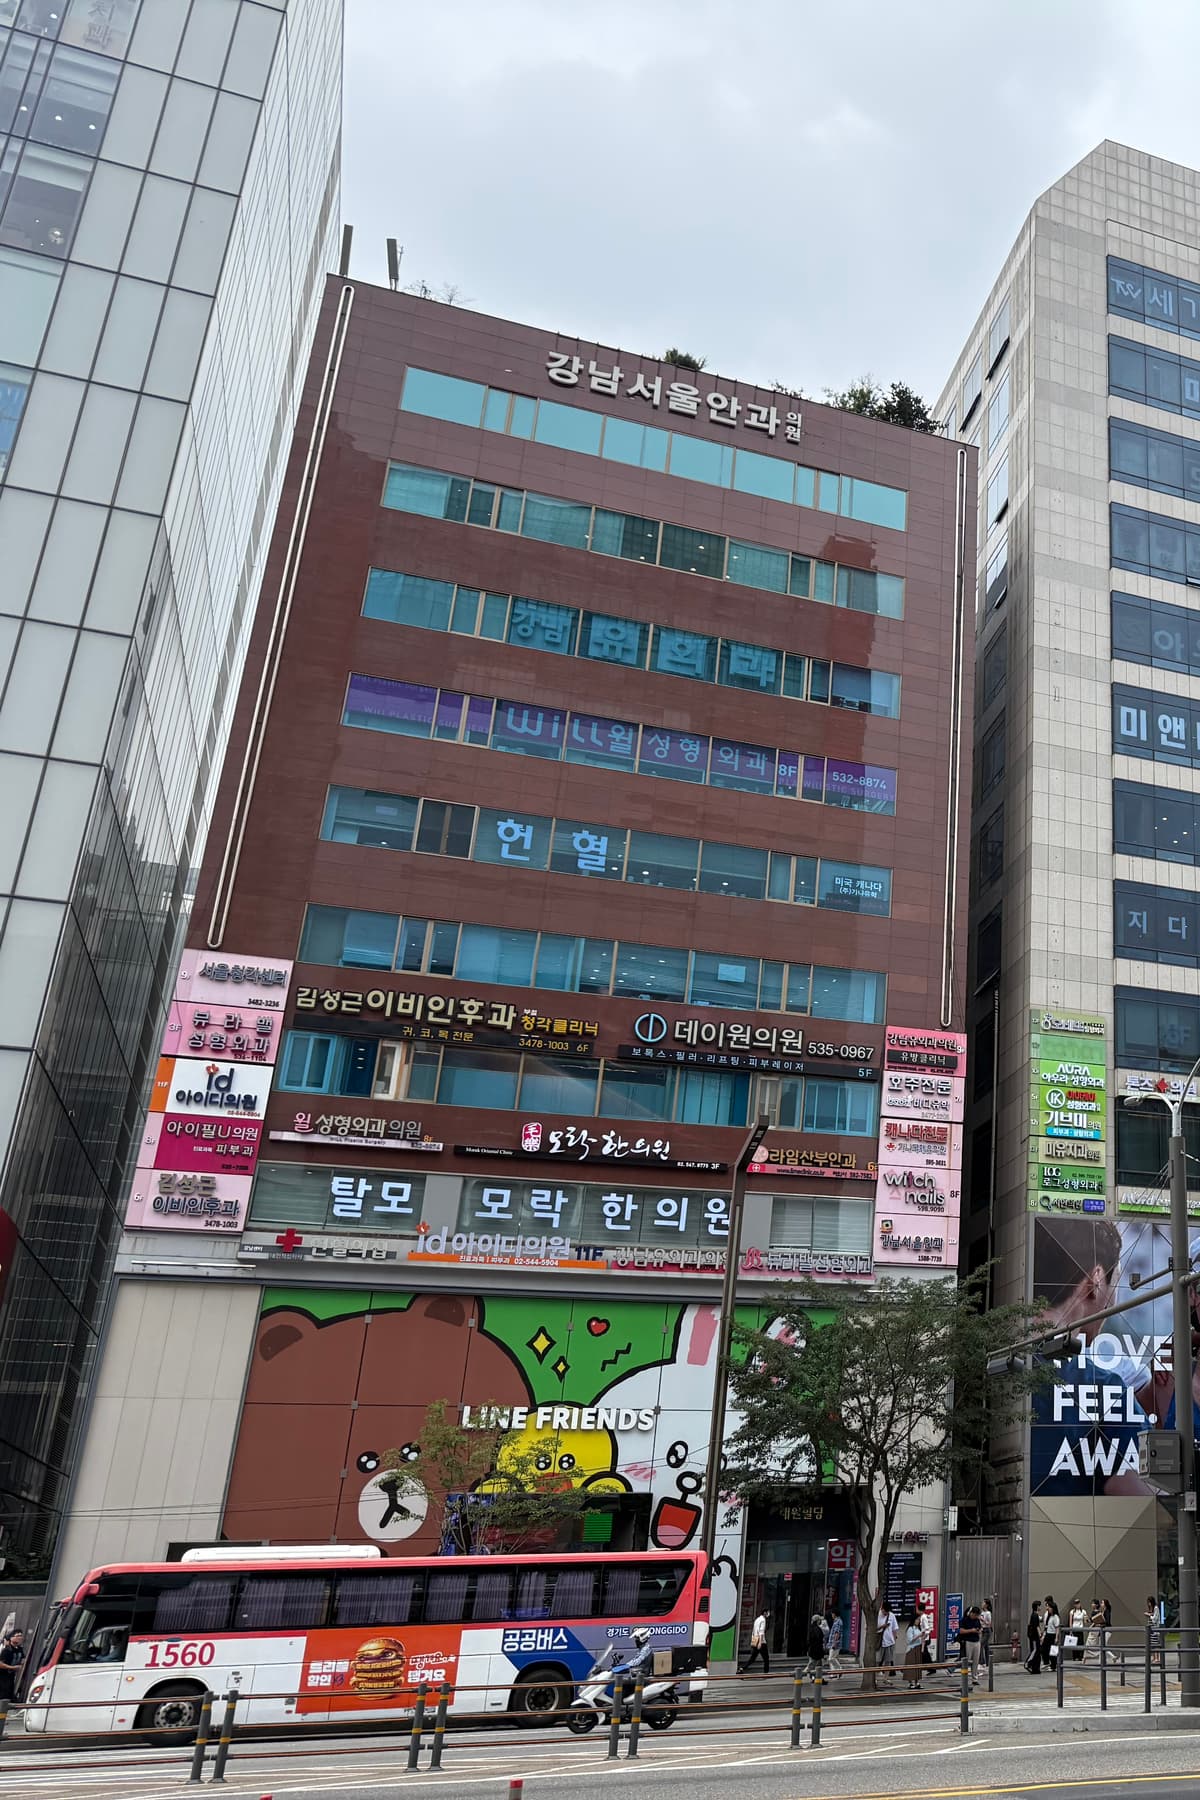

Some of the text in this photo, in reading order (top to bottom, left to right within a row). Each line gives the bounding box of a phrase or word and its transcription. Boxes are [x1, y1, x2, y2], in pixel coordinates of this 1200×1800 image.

[545, 350, 784, 438] 강남서울안과
[778, 764, 797, 777] 8F
[832, 772, 886, 789] 532-8874
[835, 876, 882, 891] 미국 캐나다
[452, 1030, 474, 1042] 전문
[521, 1015, 599, 1036] 청각클리닉
[188, 1032, 269, 1053] 성형외과
[519, 1038, 589, 1053] 3478-1003 6F
[674, 1019, 874, 1060] 데이원의원 535-0967
[207, 1066, 234, 1092] id
[858, 1067, 872, 1078] 5F
[176, 1089, 257, 1111] 아이디의원
[1043, 1110, 1087, 1129] 기브미
[885, 1122, 948, 1144] 캐나다전문
[215, 1144, 253, 1157] 피부과
[769, 1148, 856, 1169] 라임산부인과
[1046, 1141, 1088, 1160] 미유치과
[884, 1171, 935, 1188] witch
[153, 1196, 240, 1218] 이비인후과
[331, 1176, 729, 1236] 탈모 모락 한의원
[905, 1189, 960, 1206] nails 8F
[416, 1224, 604, 1261] id 아이디의원 11F
[1053, 1385, 1158, 1423] FEEL.
[462, 1405, 654, 1431] LINE FRIENDS
[831, 1544, 854, 1568] 약
[503, 1627, 568, 1652] 공공버스
[607, 1626, 630, 1638] 경기도
[144, 1642, 216, 1668] 1560
